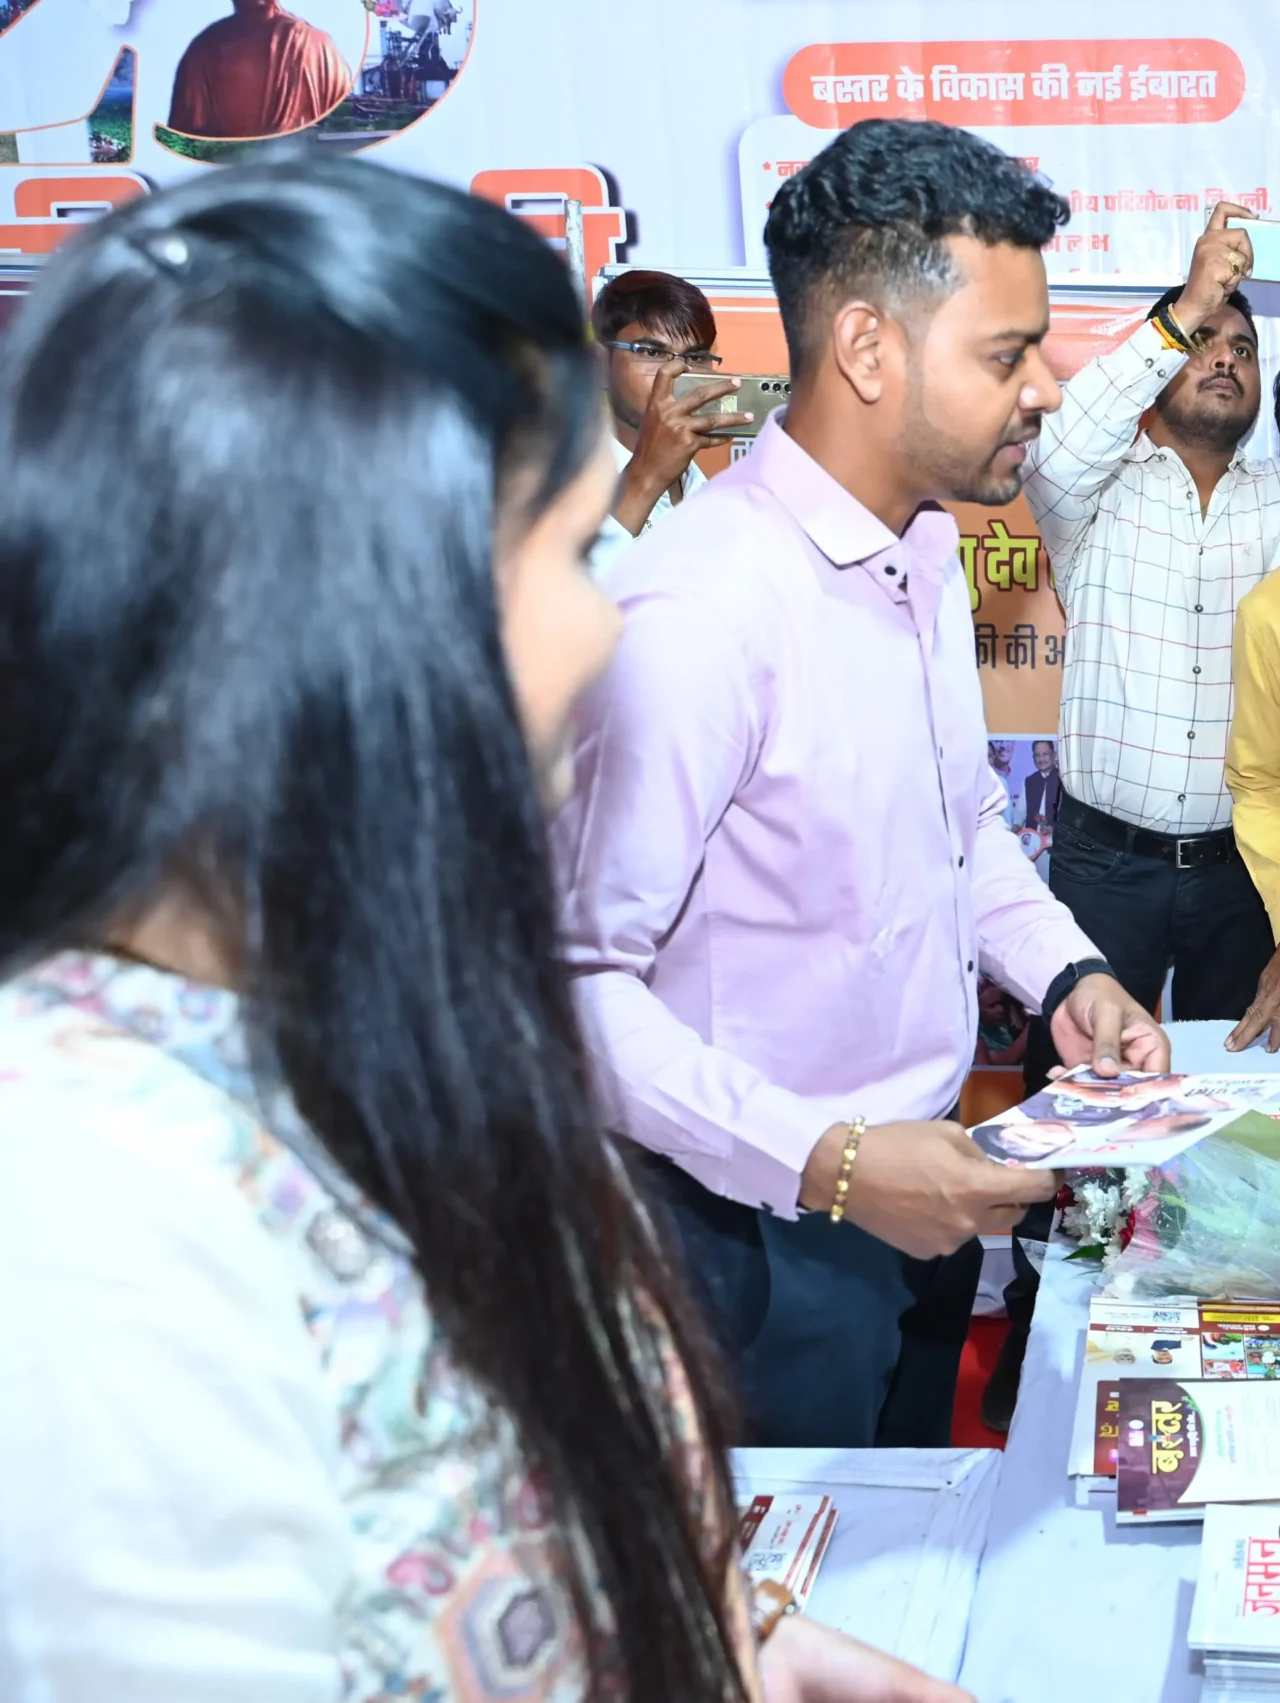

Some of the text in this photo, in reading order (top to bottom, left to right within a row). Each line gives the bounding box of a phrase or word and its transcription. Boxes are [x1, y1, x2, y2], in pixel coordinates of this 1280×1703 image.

[810, 63, 1219, 103] बस्तर के विकास की नई ईबारत
[1103, 189, 1200, 213] परियोजना
[1066, 234, 1110, 252] लाभ
[981, 519, 1042, 592] देव
[1003, 623, 1039, 670] की
[1150, 1400, 1184, 1475] बस्तर
